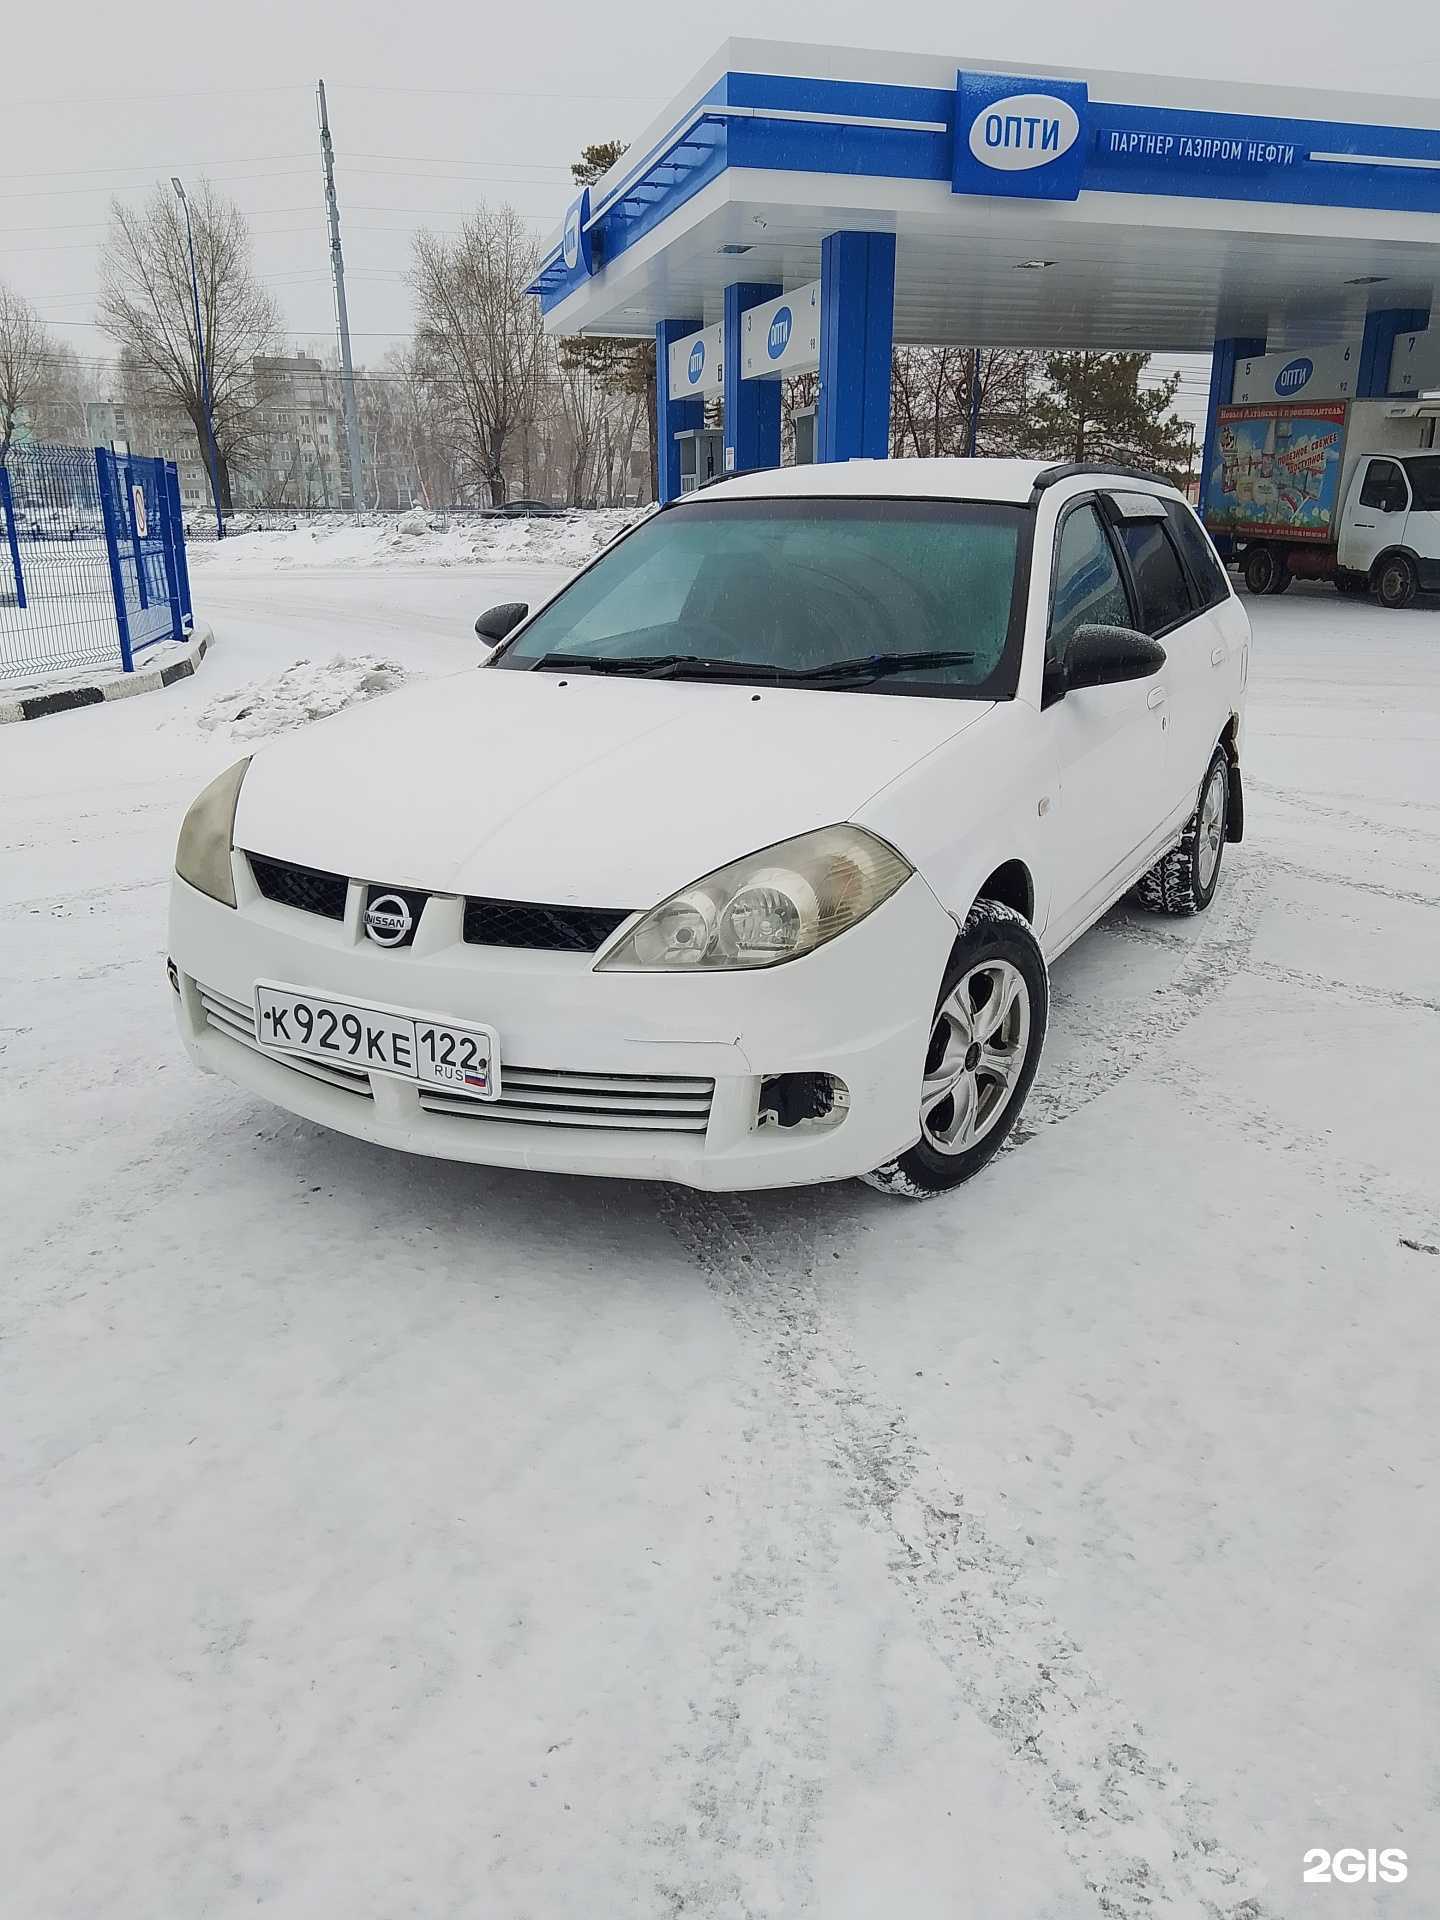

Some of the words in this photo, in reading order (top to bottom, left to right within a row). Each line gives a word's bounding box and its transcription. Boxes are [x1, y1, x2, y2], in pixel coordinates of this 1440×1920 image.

[985, 114, 1060, 151] ОПТИ
[1110, 132, 1174, 154] ПАРТНЕР
[1178, 137, 1242, 161] ГАЗПРОМ
[1247, 142, 1294, 165] НЕФТИ
[747, 315, 752, 332] 3
[770, 320, 788, 347] ОПТИ
[1408, 337, 1416, 352] 7
[1344, 347, 1350, 361] 6
[1245, 363, 1251, 376] 5
[1280, 367, 1307, 386] ОПТИ
[365, 914, 406, 929] NISSAN
[271, 1003, 413, 1068] К929КЕ
[420, 1029, 478, 1071] 122
[434, 1065, 464, 1082] RUS
